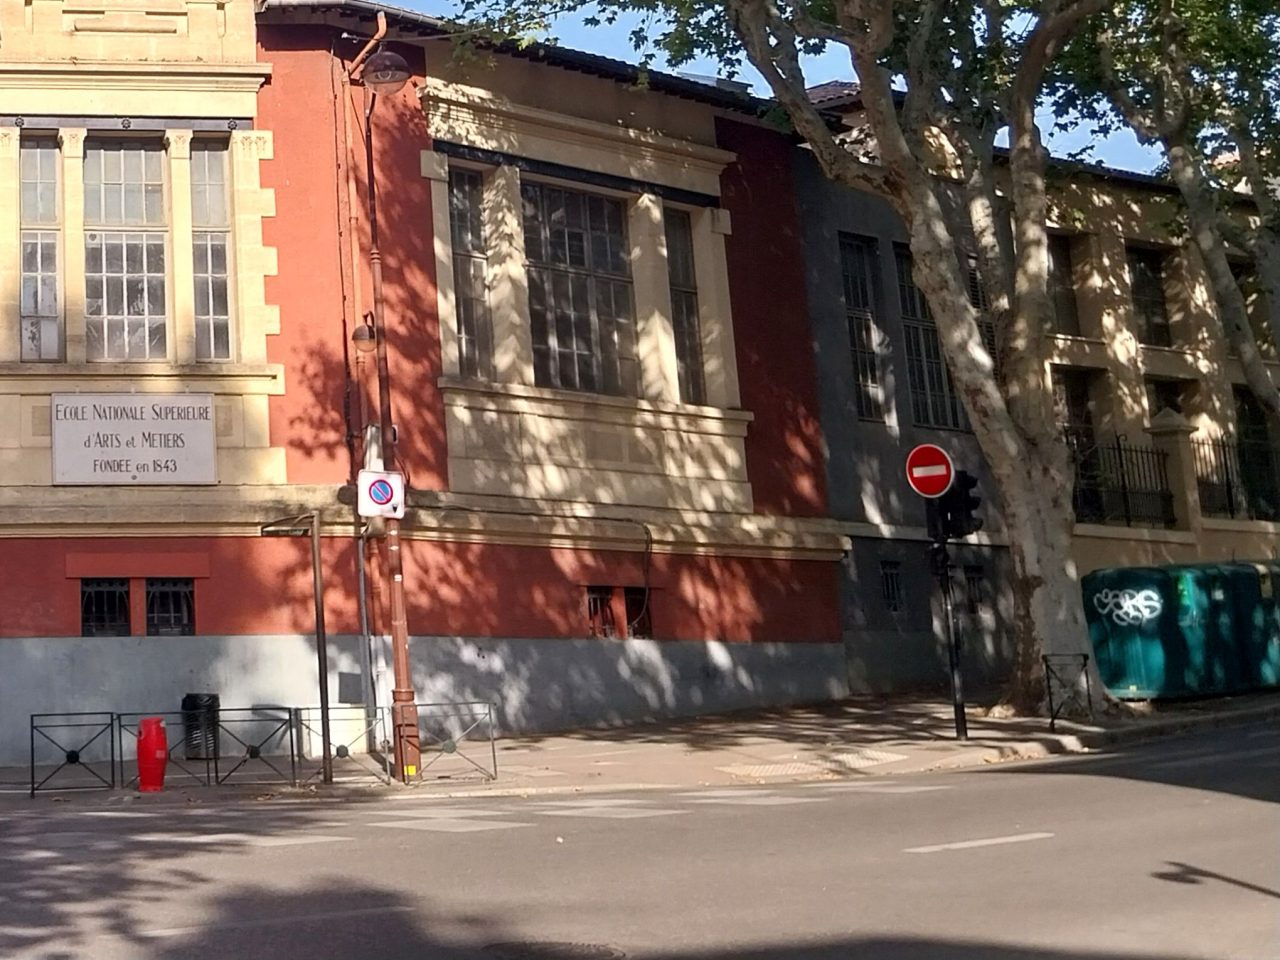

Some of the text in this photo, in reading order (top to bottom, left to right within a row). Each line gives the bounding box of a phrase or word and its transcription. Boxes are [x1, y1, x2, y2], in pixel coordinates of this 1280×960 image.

[55, 403, 211, 421] ECOLE NATIONALE SUPERIEURE
[83, 431, 185, 449] d'ARTS et METIERS
[93, 459, 178, 473] FONDEE en 1843
